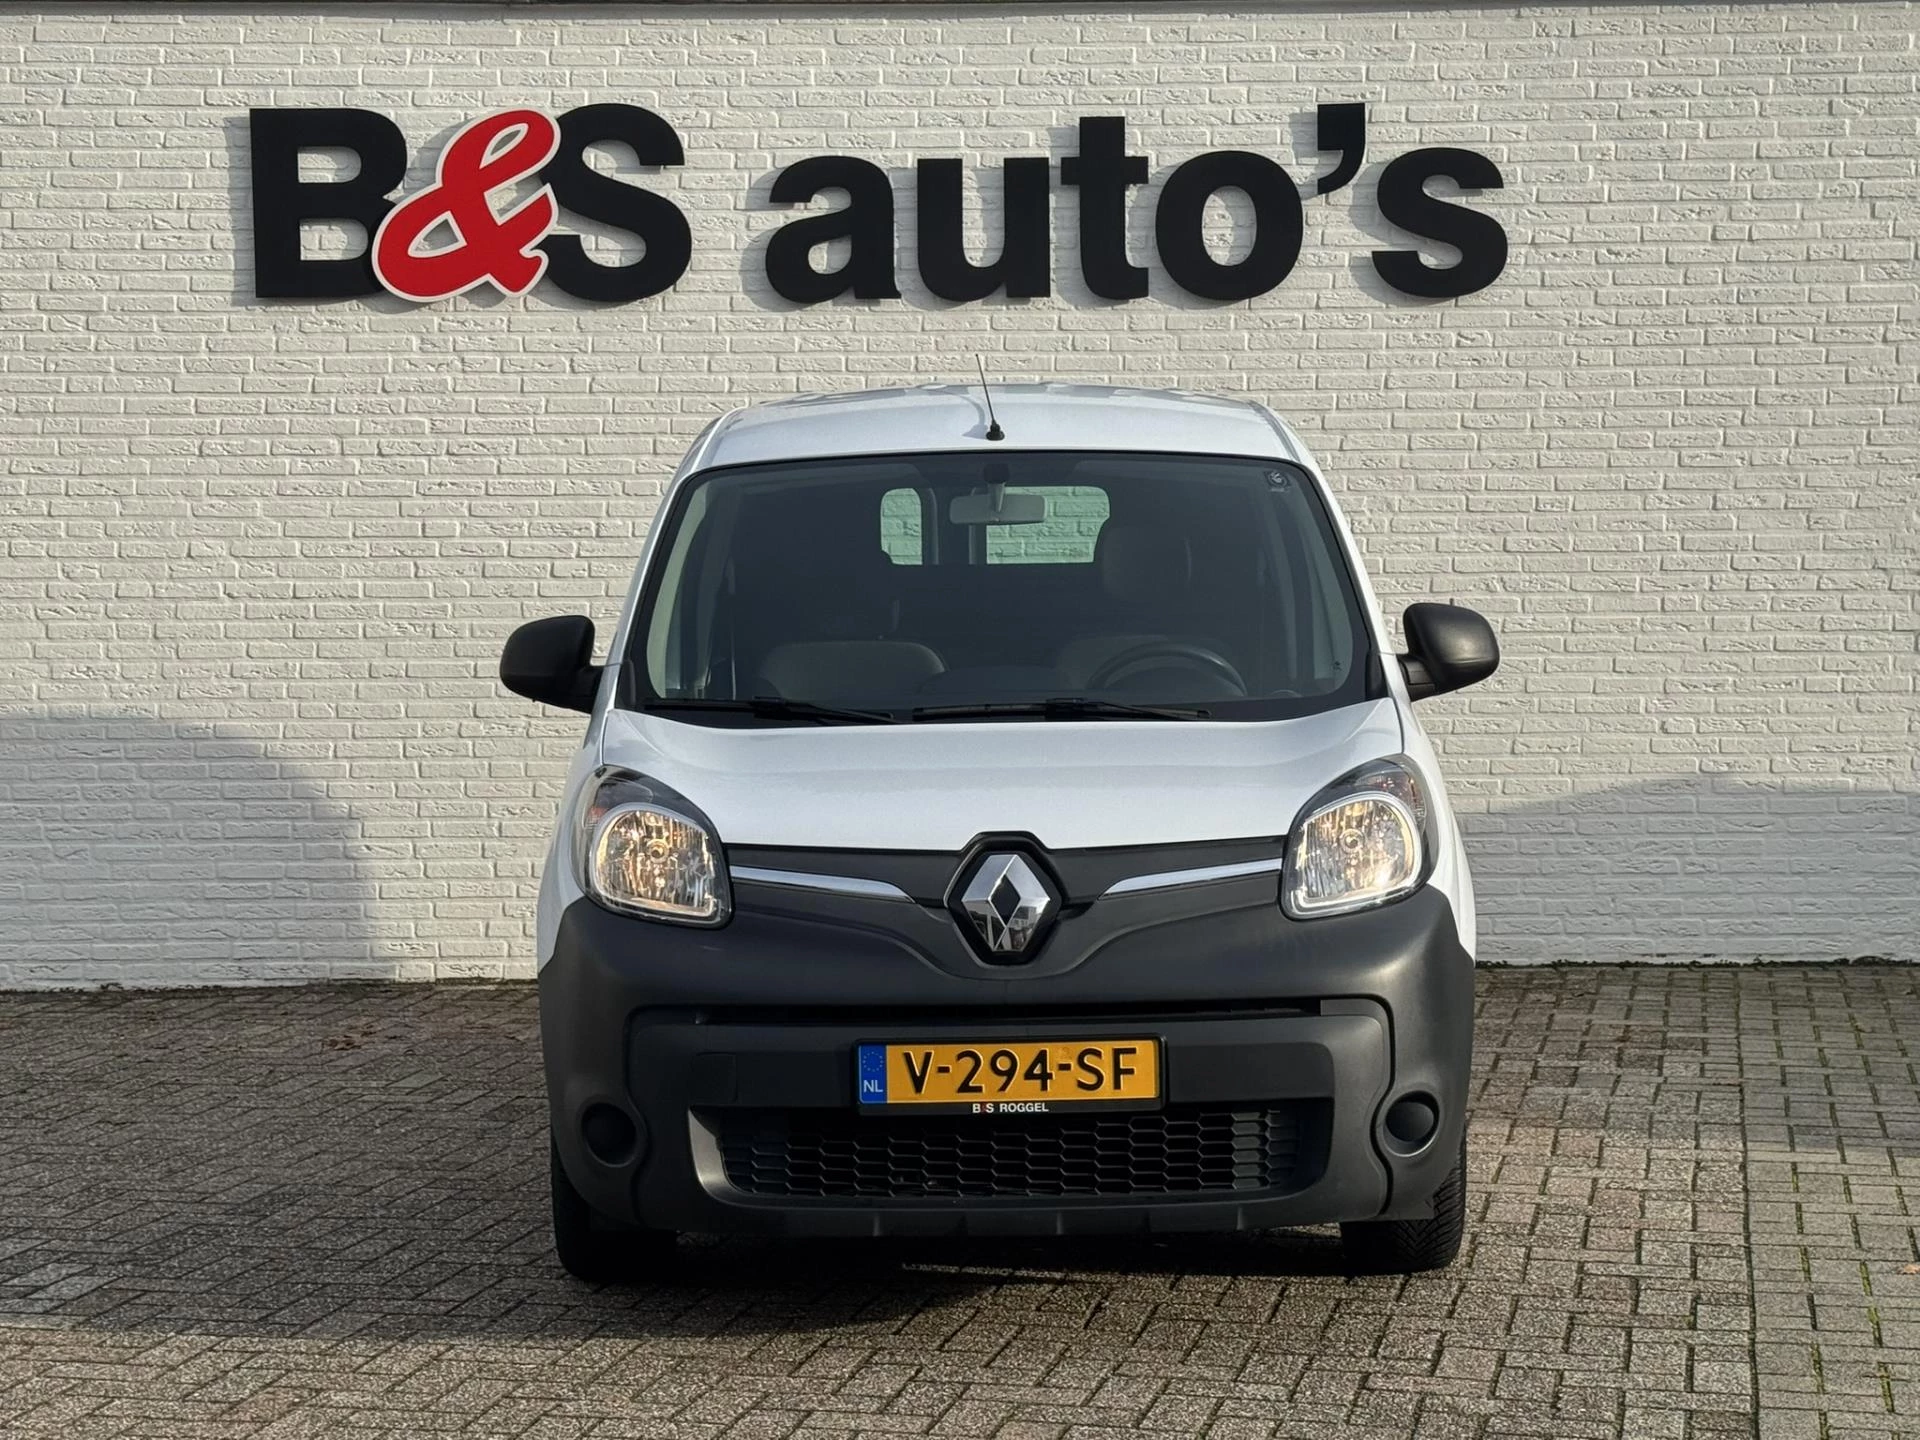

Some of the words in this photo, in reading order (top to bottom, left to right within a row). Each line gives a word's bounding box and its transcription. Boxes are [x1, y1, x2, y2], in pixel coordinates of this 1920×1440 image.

[250, 103, 692, 302] B&S
[765, 103, 1507, 302] auto's
[903, 1047, 1138, 1094] V-294-SF
[863, 1079, 884, 1093] NL
[999, 1102, 1049, 1113] ROGGEL
